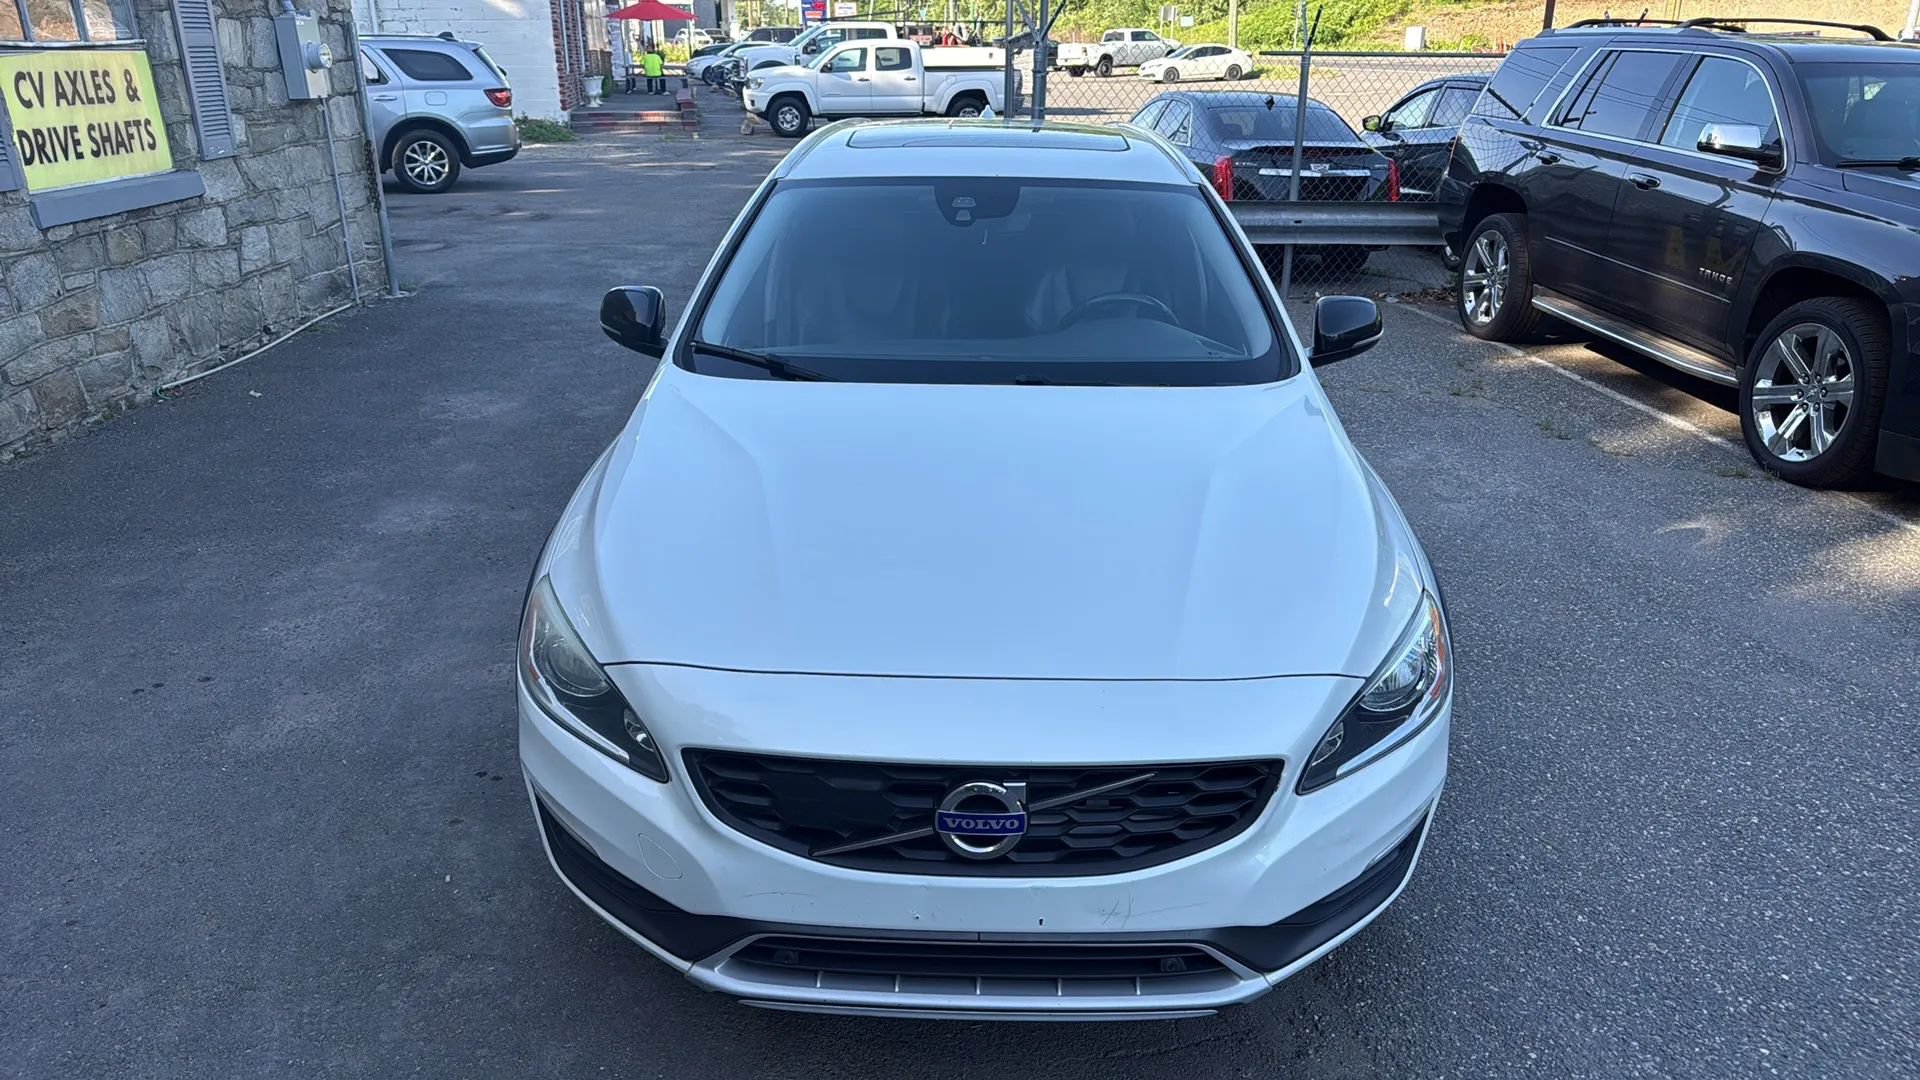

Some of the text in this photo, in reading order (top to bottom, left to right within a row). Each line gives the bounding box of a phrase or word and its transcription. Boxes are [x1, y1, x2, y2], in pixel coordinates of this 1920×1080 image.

[14, 68, 141, 109] CV AXLES &
[16, 117, 157, 166] DRIVE SHAFTS
[1699, 267, 1733, 285] TAHOE
[942, 816, 1020, 830] VOLVO
